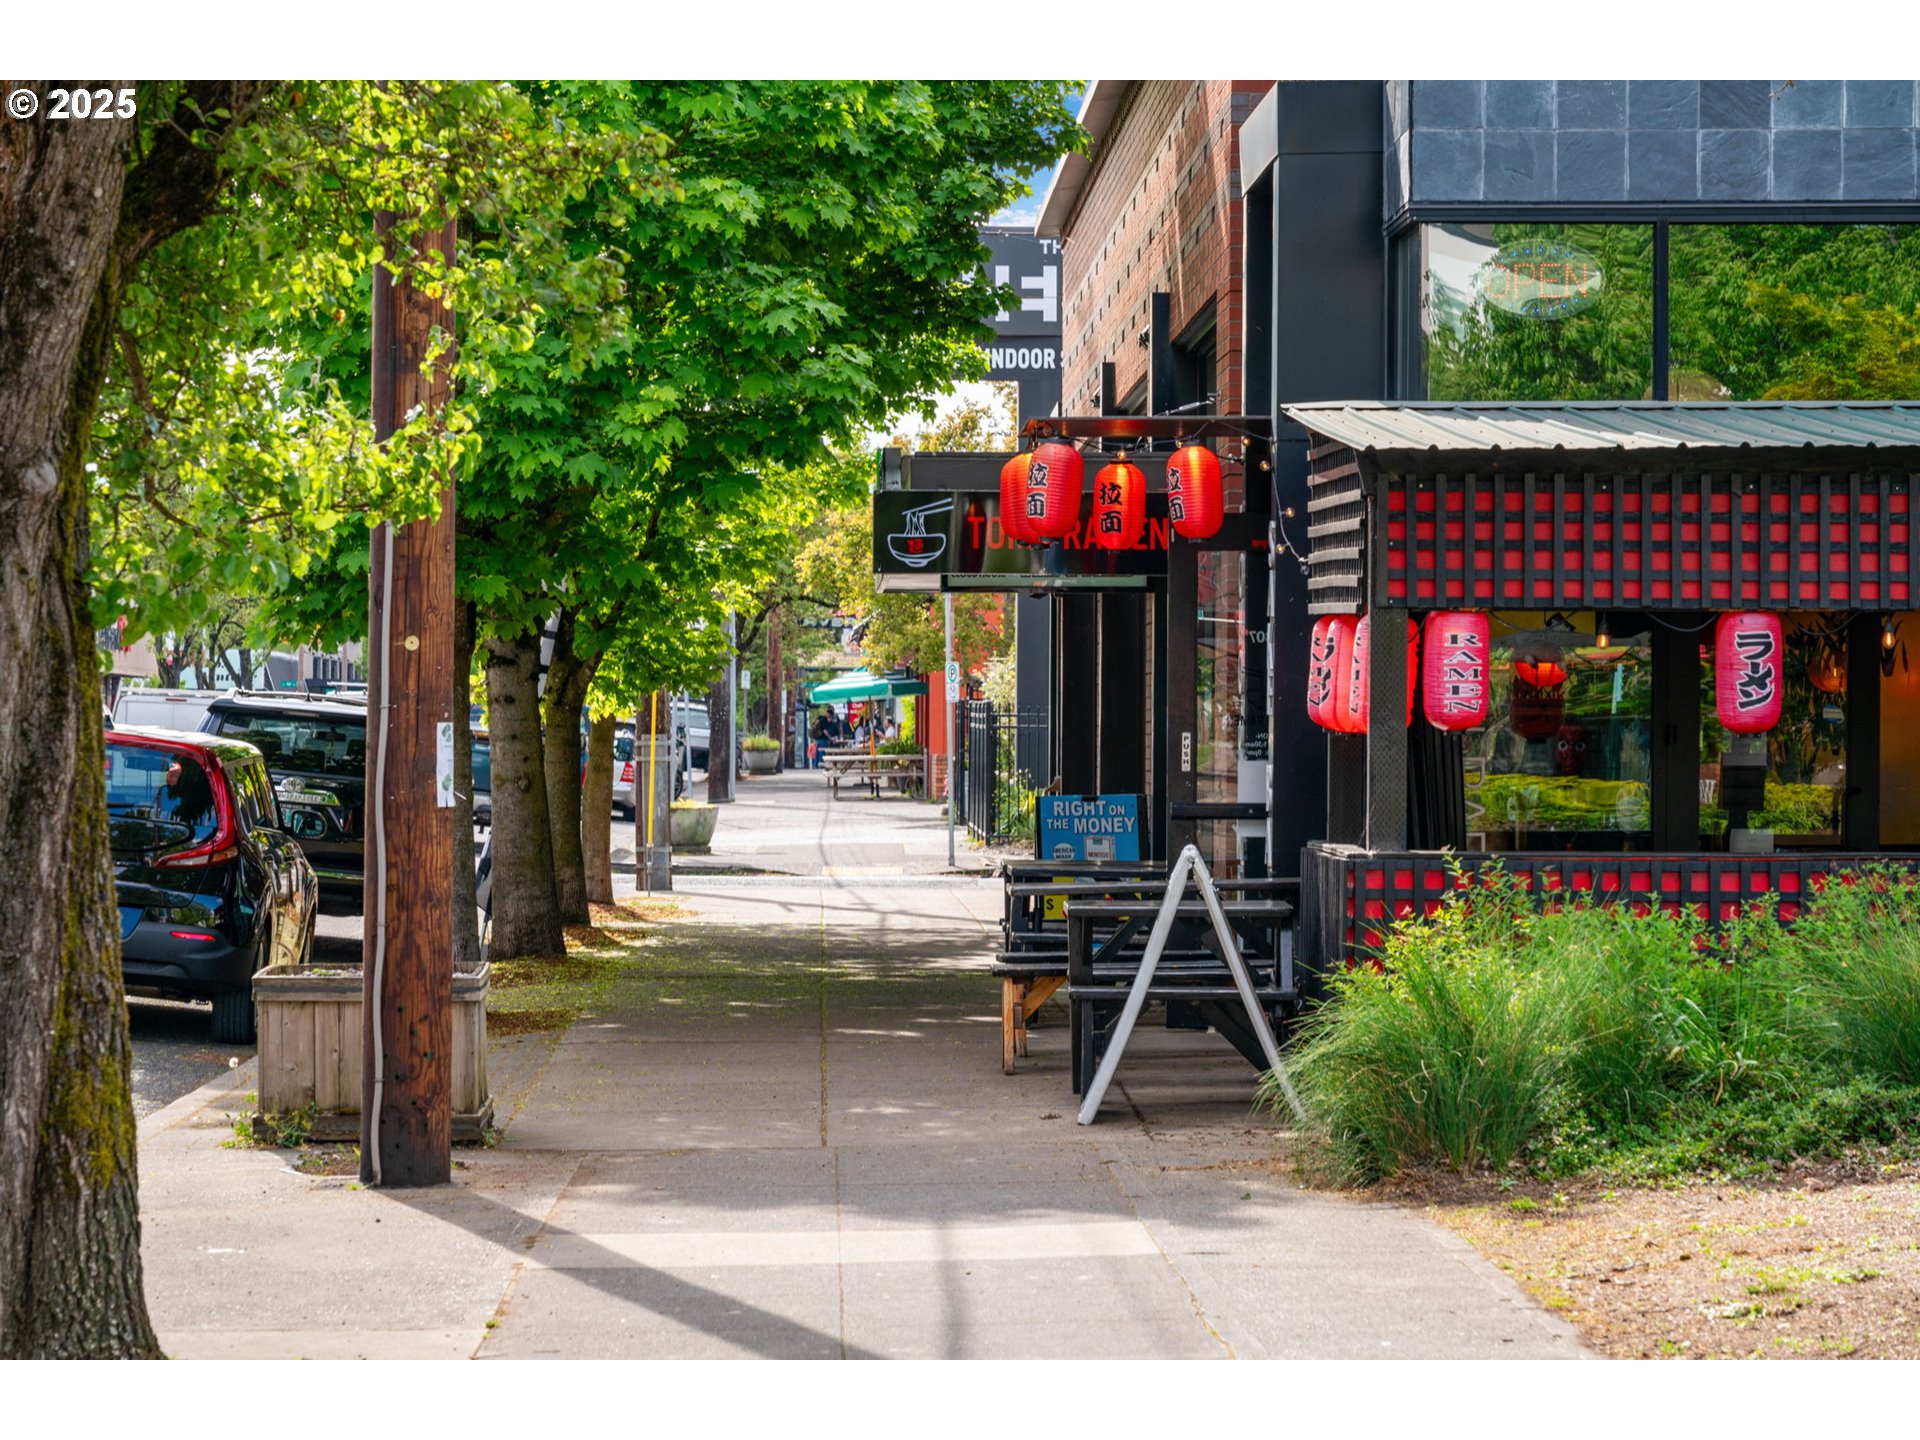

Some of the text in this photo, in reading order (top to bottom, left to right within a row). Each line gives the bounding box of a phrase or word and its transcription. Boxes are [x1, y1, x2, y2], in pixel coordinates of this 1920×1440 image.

[1485, 263, 1588, 299] OPEN
[1099, 481, 1123, 535] 拉面
[1443, 632, 1483, 713] RAMEN
[1736, 631, 1774, 711] ラーメン
[1046, 816, 1135, 833] THE MONEY
[1053, 800, 1125, 816] RIGHT ON
